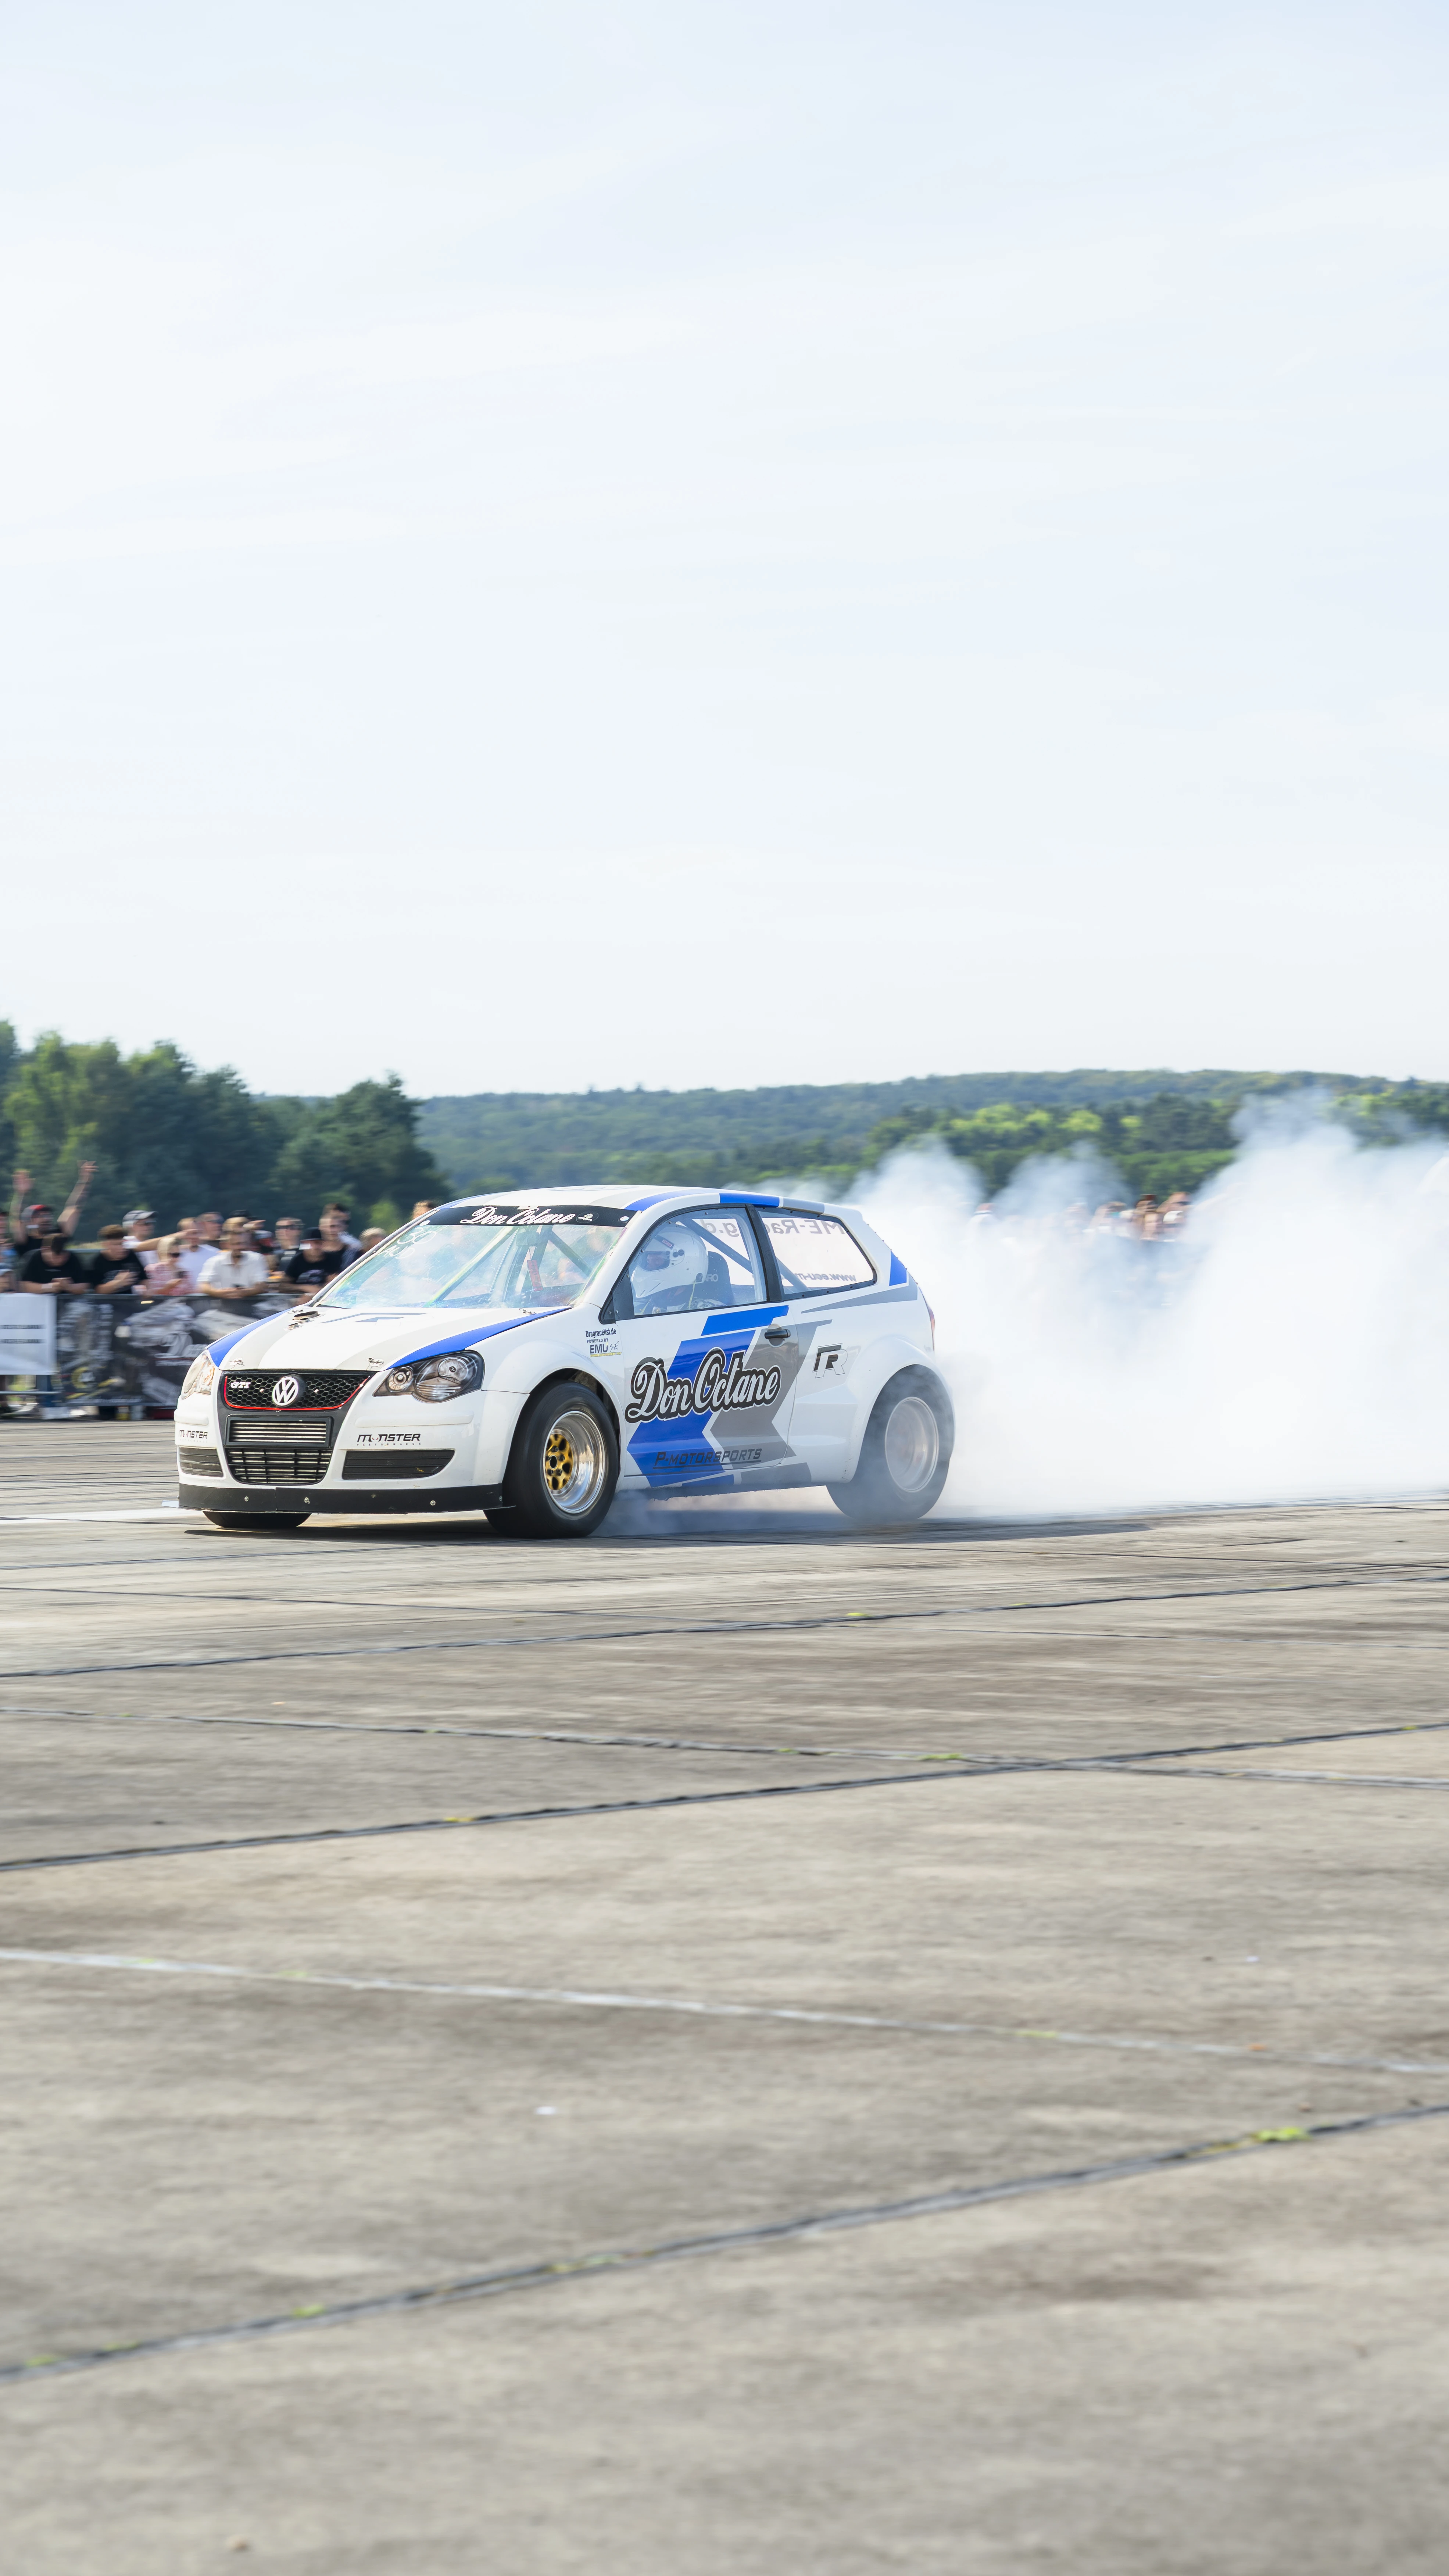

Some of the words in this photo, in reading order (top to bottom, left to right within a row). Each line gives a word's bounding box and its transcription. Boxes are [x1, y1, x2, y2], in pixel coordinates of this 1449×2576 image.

[460, 1206, 508, 1224] Don
[586, 1328, 616, 1338] Dragracelist.de
[590, 1344, 608, 1354] EMU
[626, 1359, 693, 1421] Don
[693, 1349, 780, 1413] Octane
[654, 1448, 762, 1466] P-MOTORSPORTS
